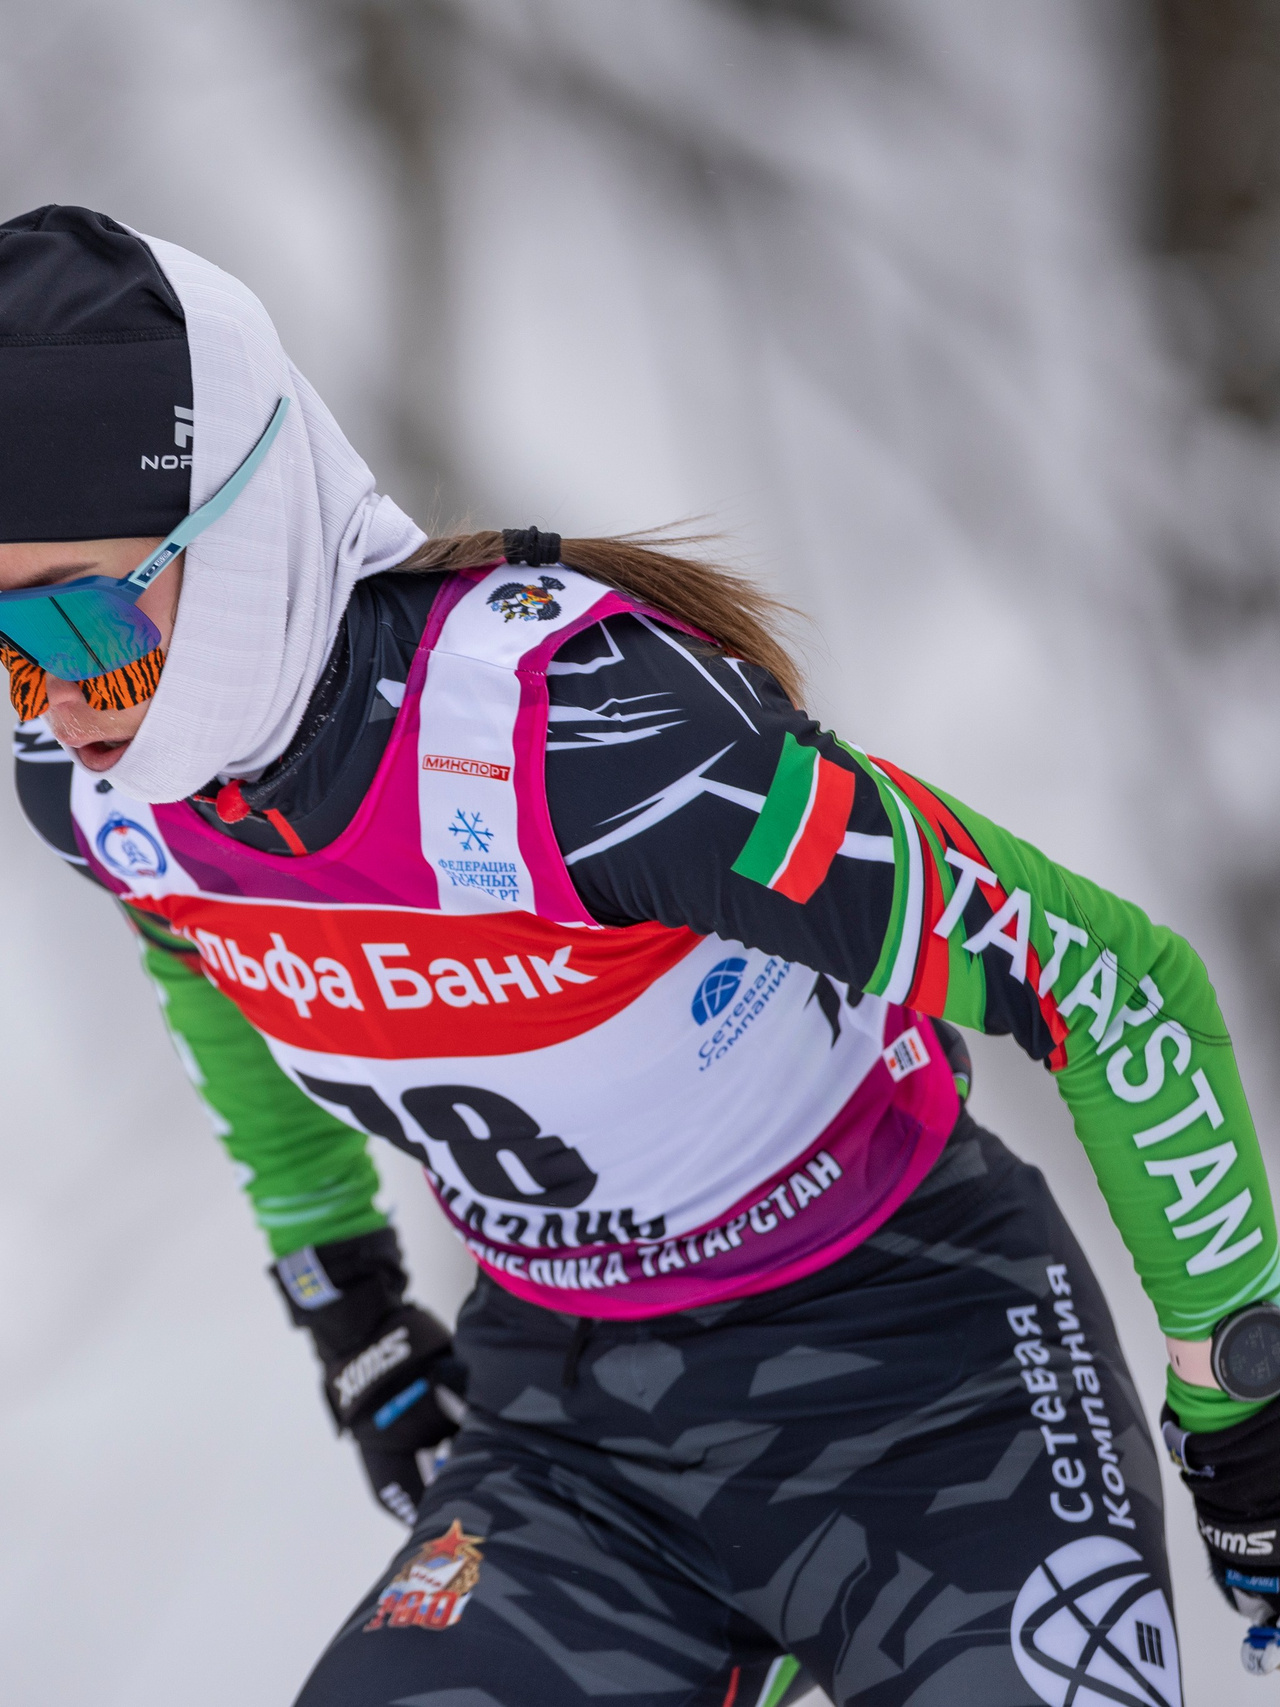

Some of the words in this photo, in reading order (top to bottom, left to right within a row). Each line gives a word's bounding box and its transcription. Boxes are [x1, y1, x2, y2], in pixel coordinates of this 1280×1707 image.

[424, 757, 509, 780] МИНСПОРТ
[438, 859, 517, 874] ФЕДЕРАЦИЯ
[170, 925, 365, 1018] льфа
[361, 944, 598, 1010] Банк
[933, 846, 1264, 1277] TATARSTAN
[638, 1150, 843, 1277] ТАТАРСТАН
